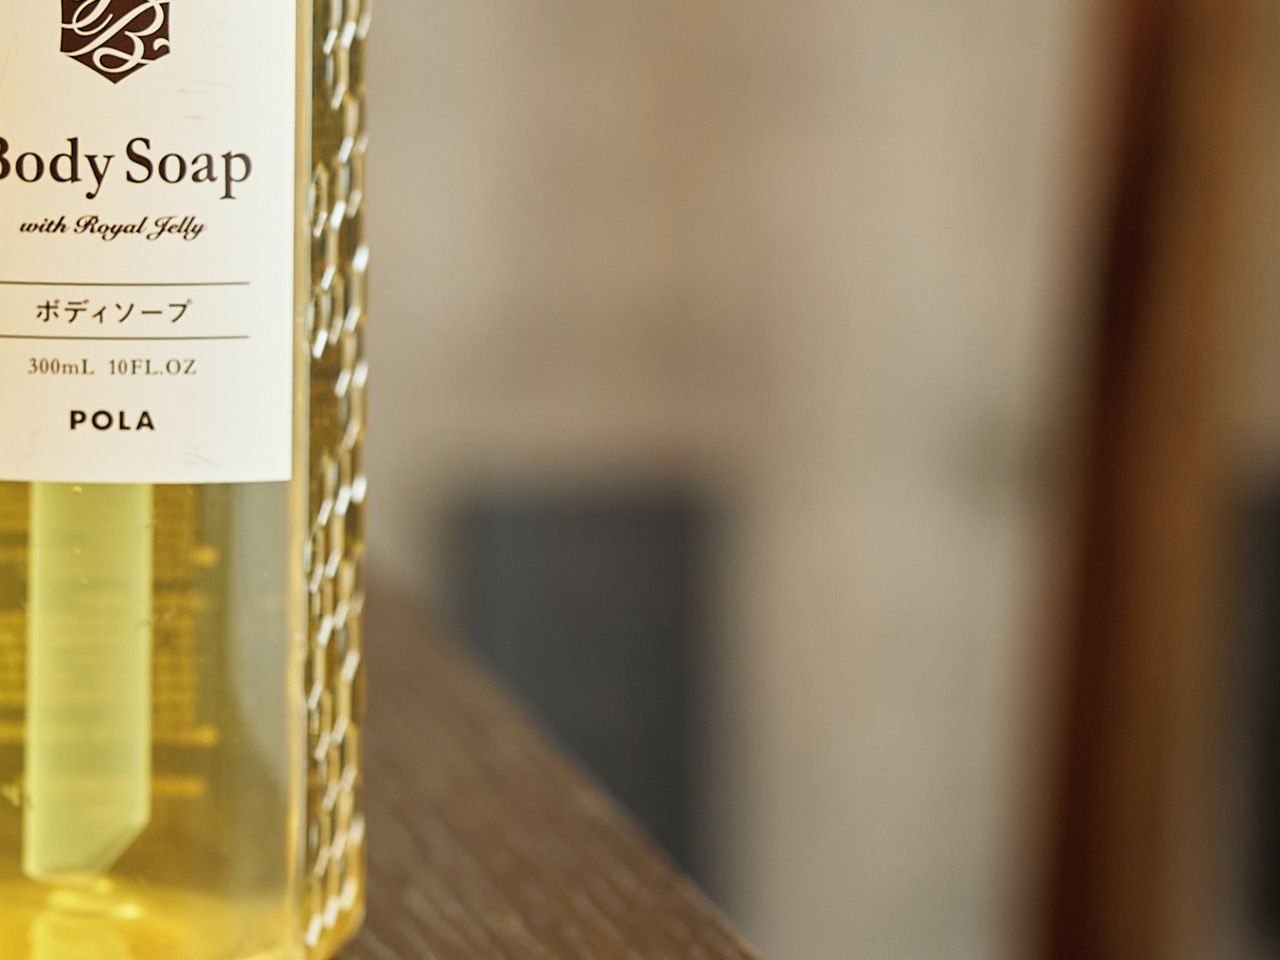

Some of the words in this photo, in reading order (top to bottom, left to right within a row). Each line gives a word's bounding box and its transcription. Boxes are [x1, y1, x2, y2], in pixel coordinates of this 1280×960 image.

[125, 136, 252, 200] Soap
[19, 215, 67, 234] with
[73, 214, 147, 241] Royal
[146, 215, 205, 241] Jelly
[35, 298, 191, 324] ボディソープ
[28, 357, 95, 376] 300mL
[109, 358, 197, 376] 10FL.OZ
[69, 409, 155, 432] POLA
